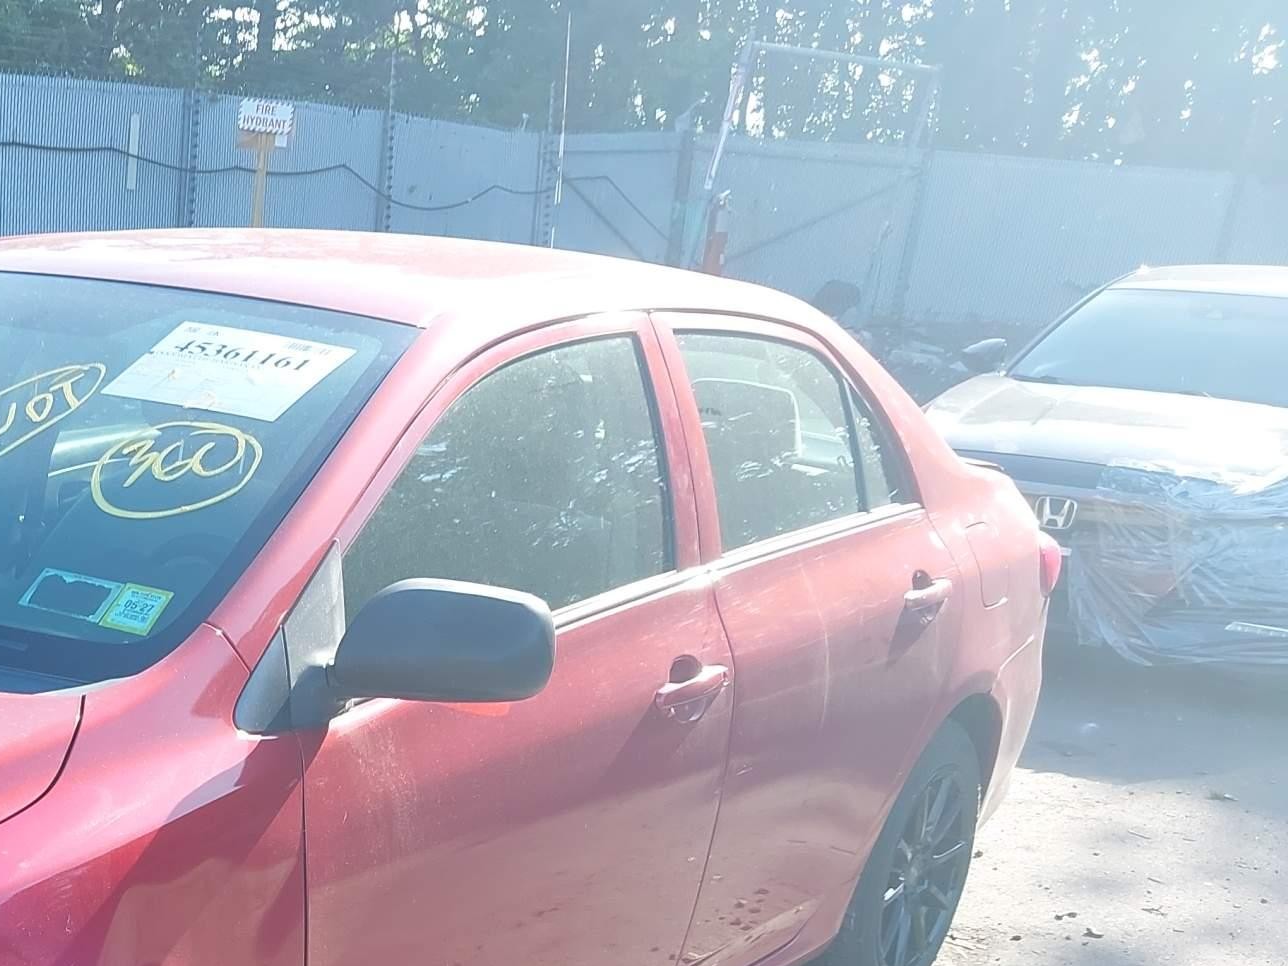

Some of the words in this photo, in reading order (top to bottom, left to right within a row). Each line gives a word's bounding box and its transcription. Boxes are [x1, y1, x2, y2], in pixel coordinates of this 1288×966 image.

[255, 104, 275, 115] FIRE
[242, 115, 287, 129] HYDRANT
[174, 339, 311, 371] 45361161
